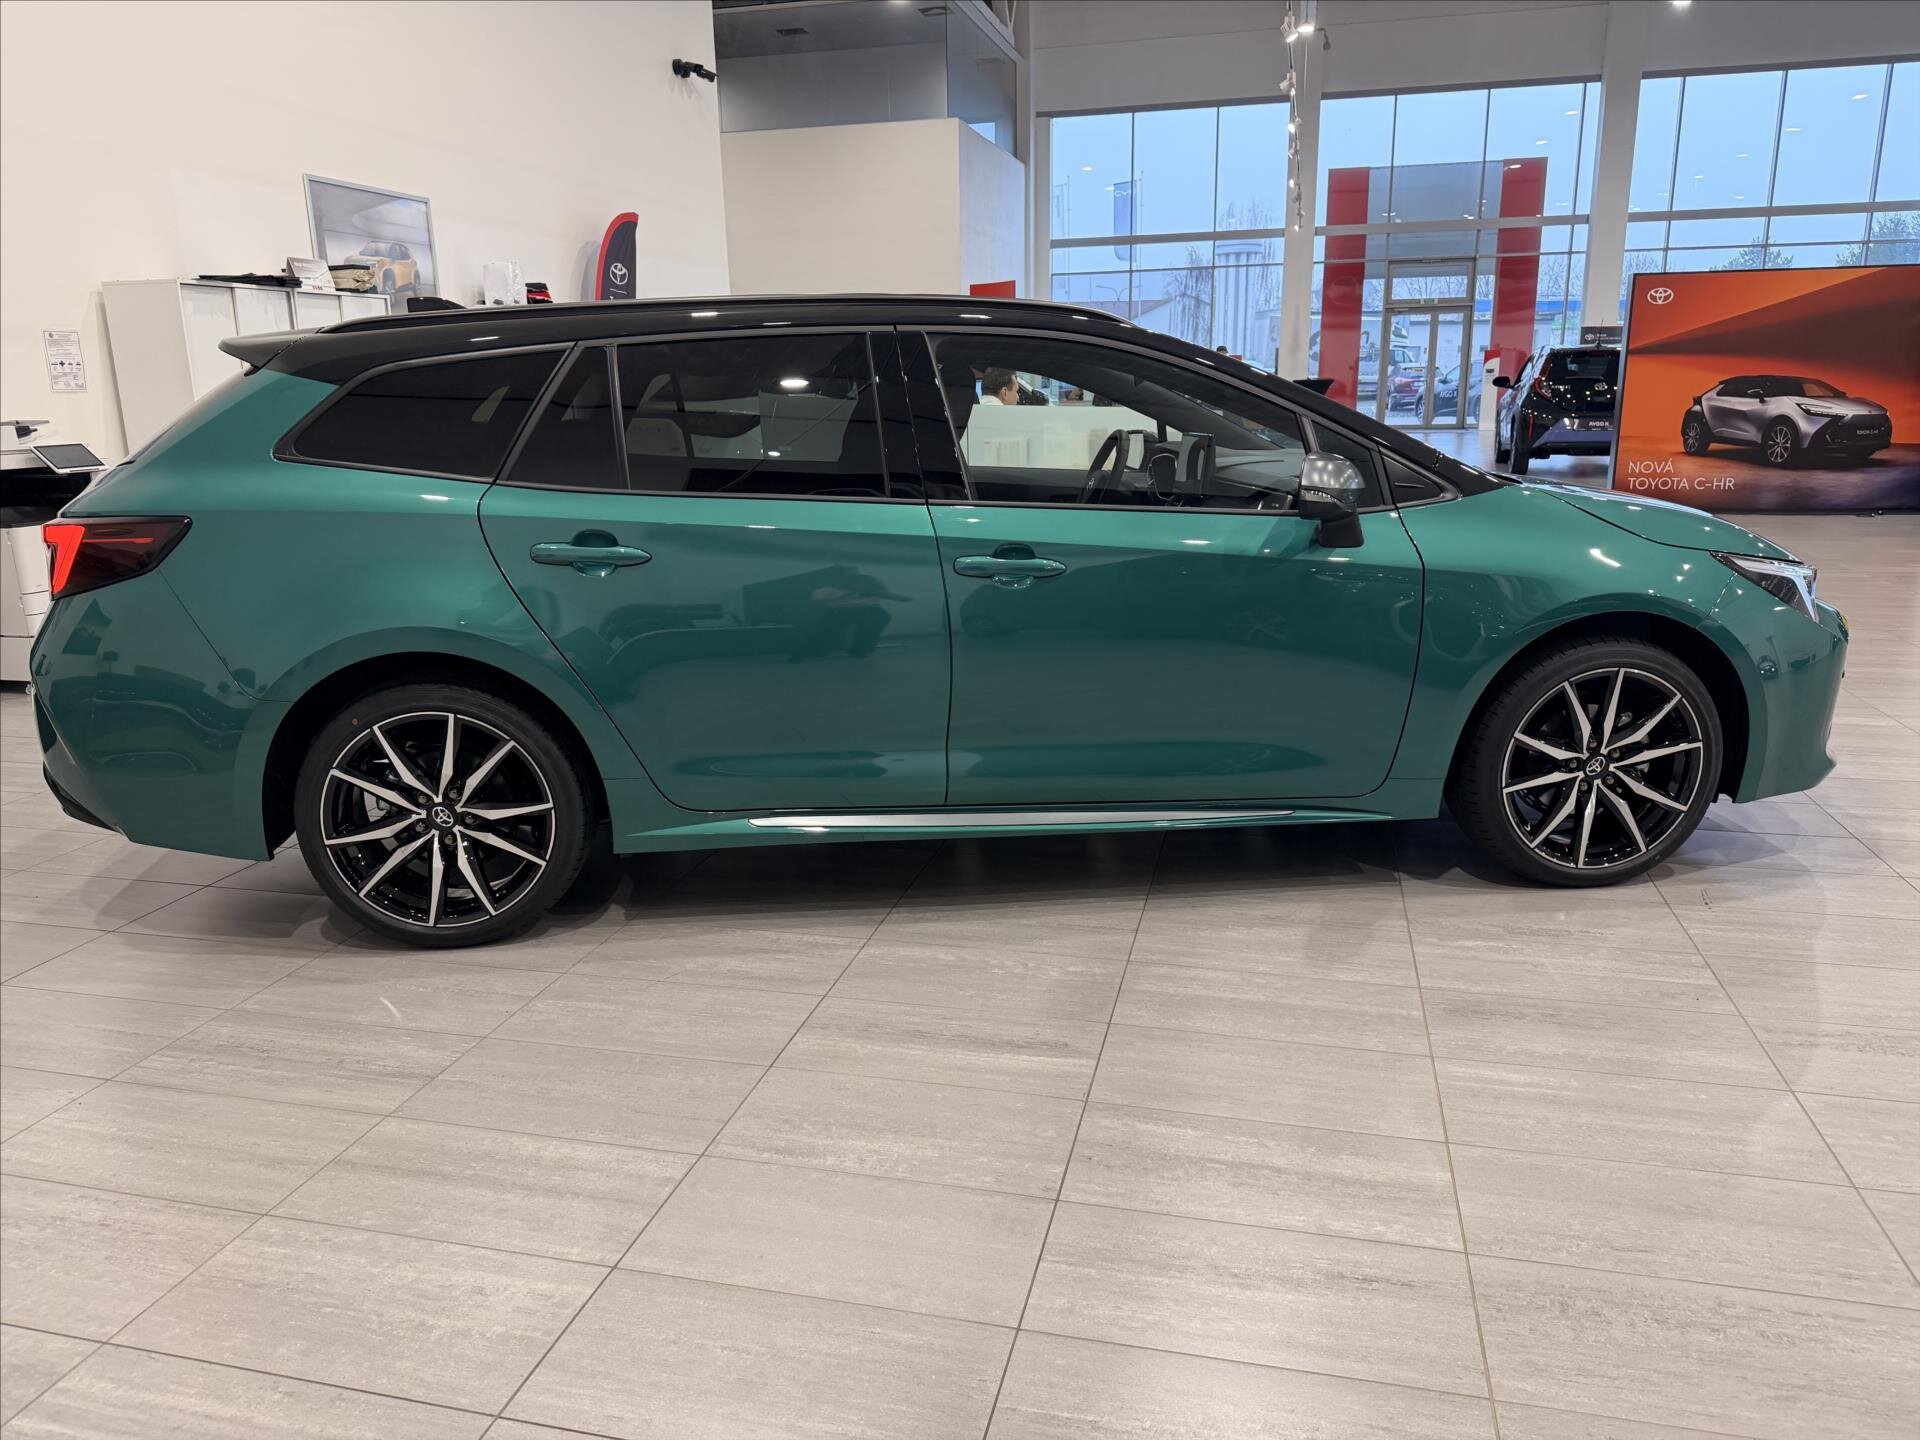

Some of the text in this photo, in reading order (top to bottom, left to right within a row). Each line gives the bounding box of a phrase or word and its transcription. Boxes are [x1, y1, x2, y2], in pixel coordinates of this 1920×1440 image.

[1628, 458, 1674, 474] NOVÁ
[1628, 477, 1735, 490] TOYOTA C-HR
